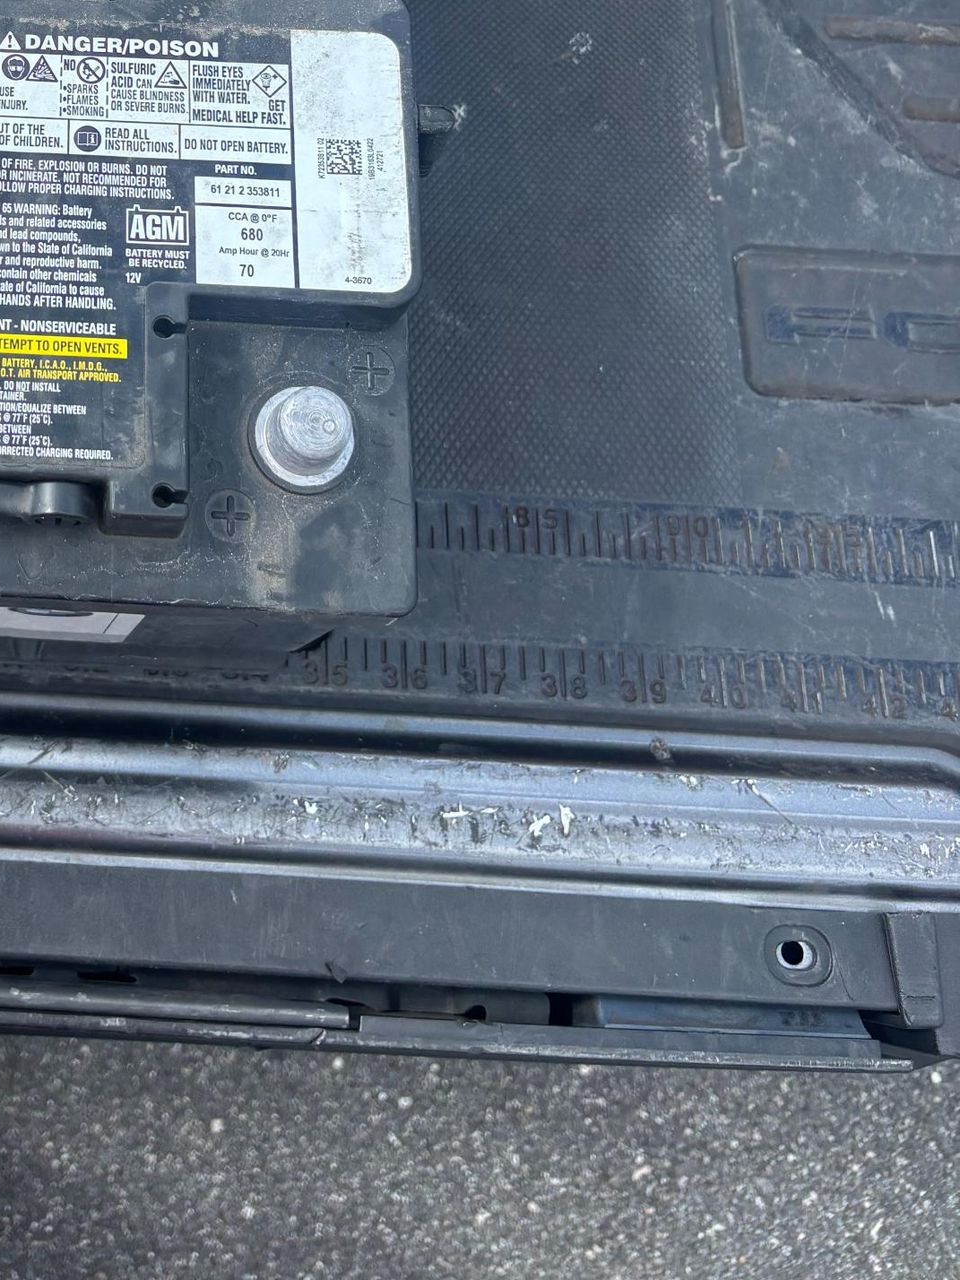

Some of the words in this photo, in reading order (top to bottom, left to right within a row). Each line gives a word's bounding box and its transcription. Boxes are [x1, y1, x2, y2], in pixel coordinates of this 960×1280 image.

[25, 34, 219, 57] DANGER/POISON
[63, 59, 75, 71] NO
[111, 62, 156, 75] SULFURIC
[193, 65, 218, 77] FLUSH
[222, 66, 243, 78] EYES
[193, 79, 250, 91] IMMEDIATELY
[193, 91, 214, 103] WITH
[218, 92, 250, 104] WATER.
[13, 123, 24, 134] OF
[27, 124, 45, 135] THE
[0, 134, 10, 145] OF
[13, 135, 63, 148] CHILDREN.
[185, 139, 197, 150] DO
[200, 140, 218, 150] NOT
[221, 140, 244, 152] OPEN
[248, 141, 288, 154] BATTERY.
[215, 164, 237, 175] PART
[241, 166, 257, 176] NO.
[210, 184, 222, 194] 61
[224, 185, 236, 195] 21
[239, 186, 244, 195] 2
[247, 186, 280, 198] 353811
[228, 212, 248, 221] CCA
[250, 214, 259, 223] @
[130, 215, 185, 241] AGM
[241, 228, 263, 241] 680
[125, 249, 162, 259] BATTERY
[164, 250, 190, 259] MUST
[219, 246, 237, 256] Amp
[240, 247, 259, 256] Hour
[261, 248, 269, 258] @
[271, 248, 289, 258] 20Hr
[129, 258, 139, 267] BE
[142, 259, 187, 269] RECYCLED.
[240, 264, 254, 277] 70
[125, 273, 141, 283] 12V
[345, 276, 372, 284] 4-3670
[21, 320, 116, 335] NONSERVICEABLE
[36, 340, 49, 351] TO
[53, 341, 83, 353] OPEN
[85, 342, 121, 355] VENTS.
